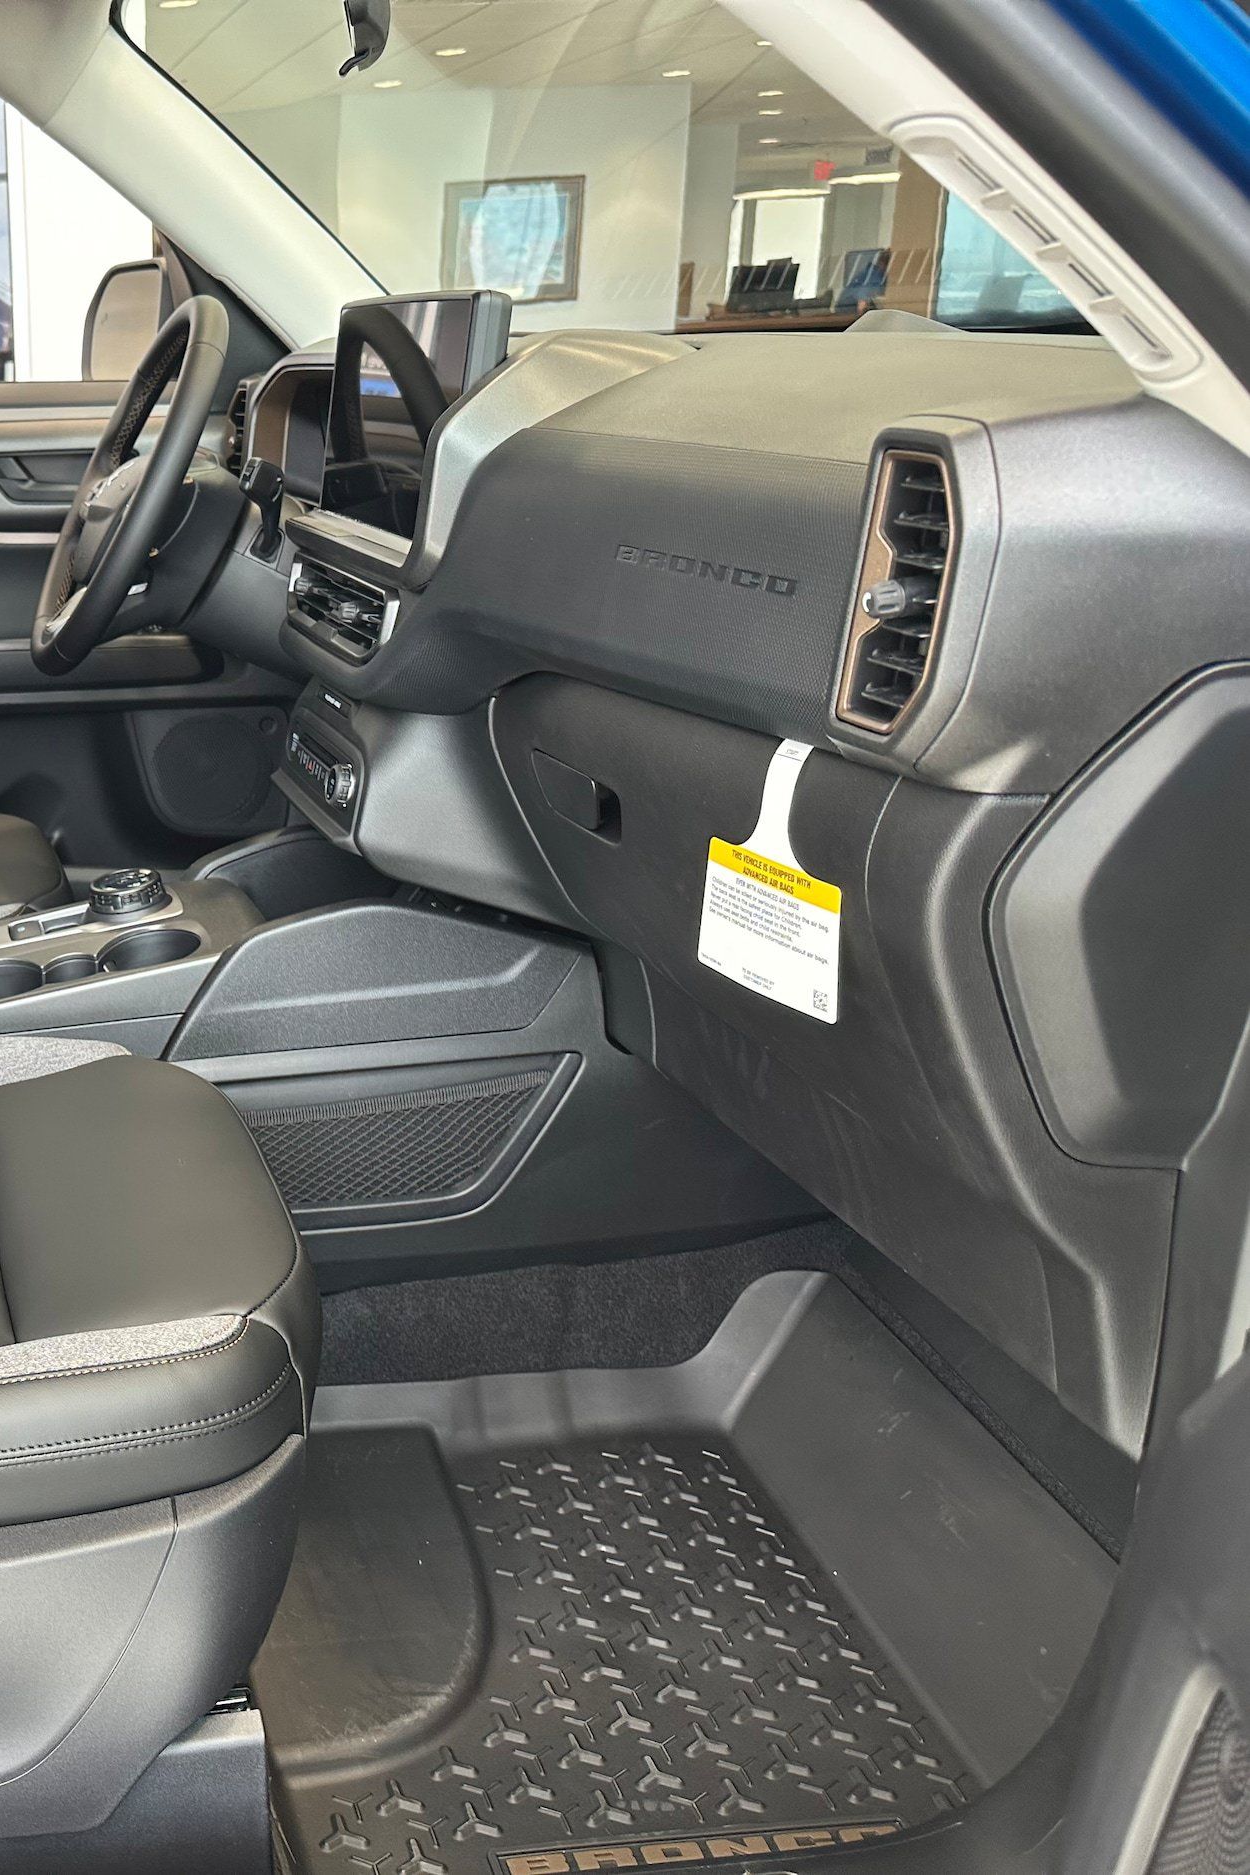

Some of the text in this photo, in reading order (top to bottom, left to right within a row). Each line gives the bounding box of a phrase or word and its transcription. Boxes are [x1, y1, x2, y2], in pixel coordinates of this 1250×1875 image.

[615, 544, 798, 597] BRONCO
[732, 849, 812, 889] THIS VEHICLE IS EQUIPPED WITH
[742, 866, 794, 895] ADVANCED AIR BAGS
